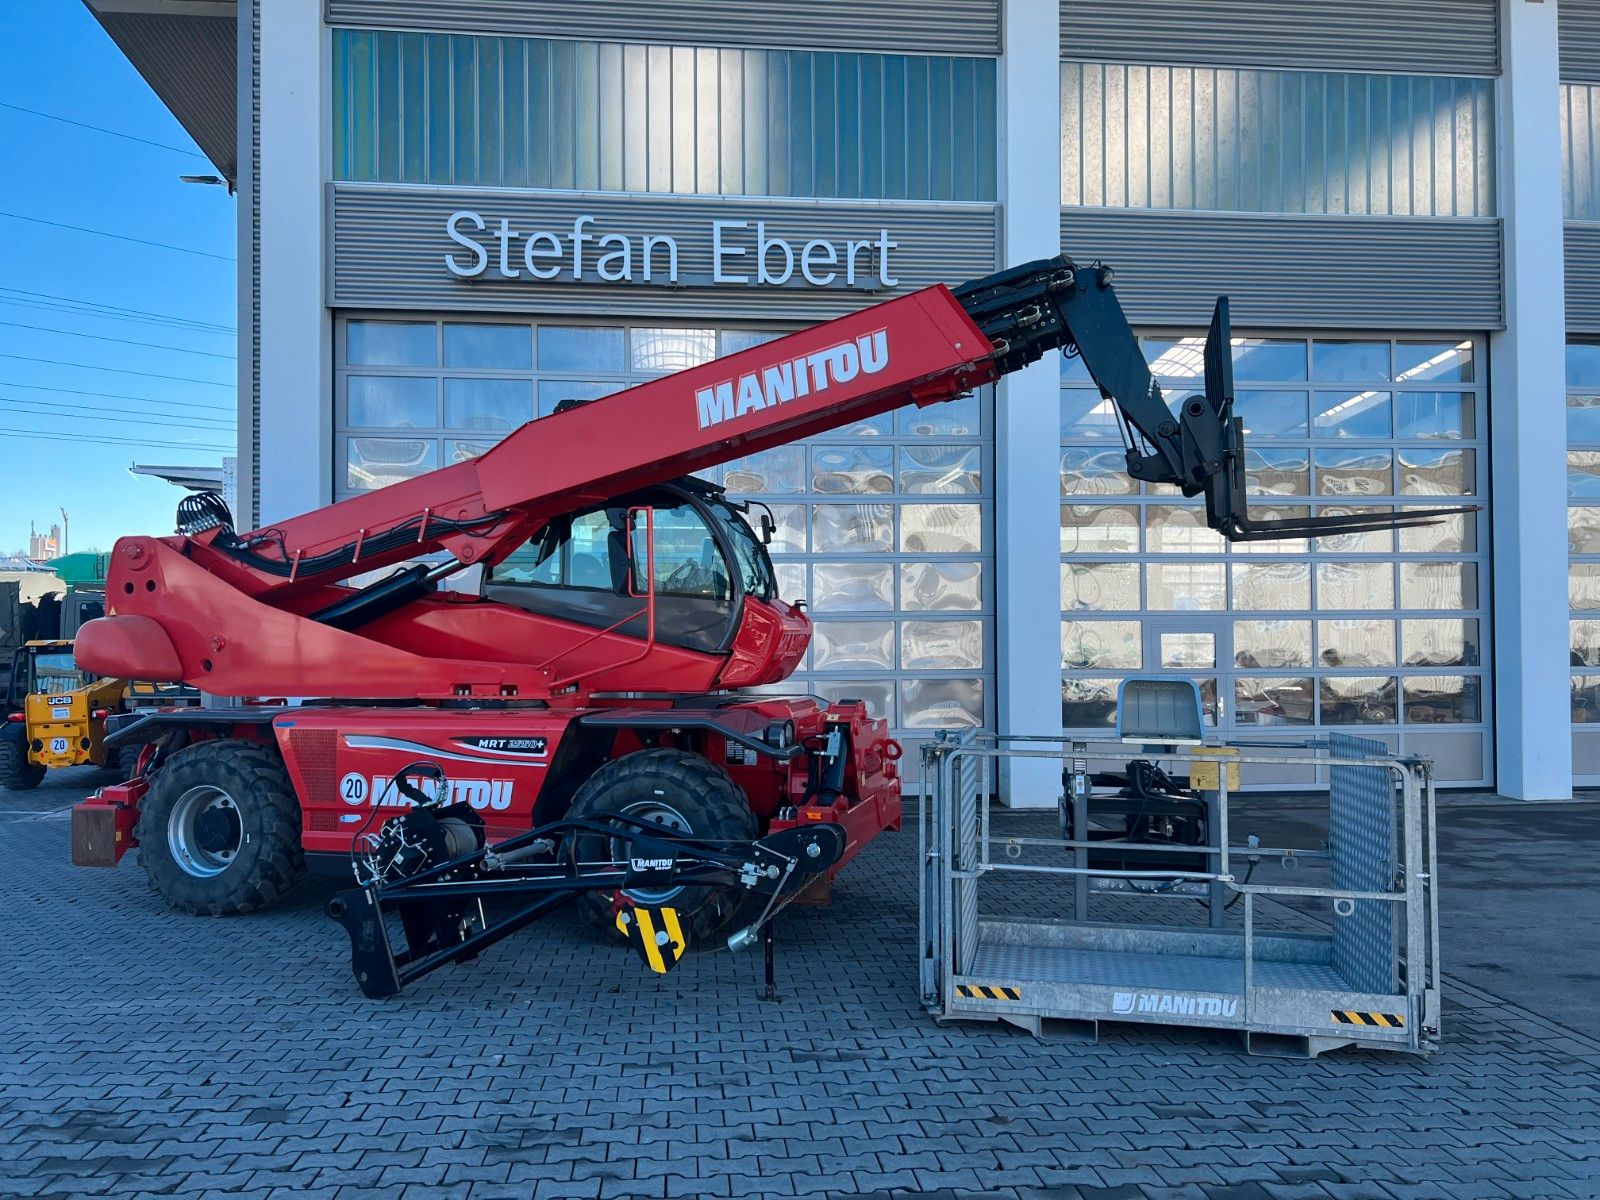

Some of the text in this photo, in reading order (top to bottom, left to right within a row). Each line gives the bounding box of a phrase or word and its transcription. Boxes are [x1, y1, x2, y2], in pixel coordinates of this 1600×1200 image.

[445, 210, 899, 287] Stefan Ebert
[695, 328, 889, 429] MANITOU
[54, 740, 65, 750] 20
[479, 739, 506, 748] MRT
[345, 778, 363, 799] 20
[637, 859, 672, 867] MANITOU
[1138, 994, 1238, 1017] MANITOU
